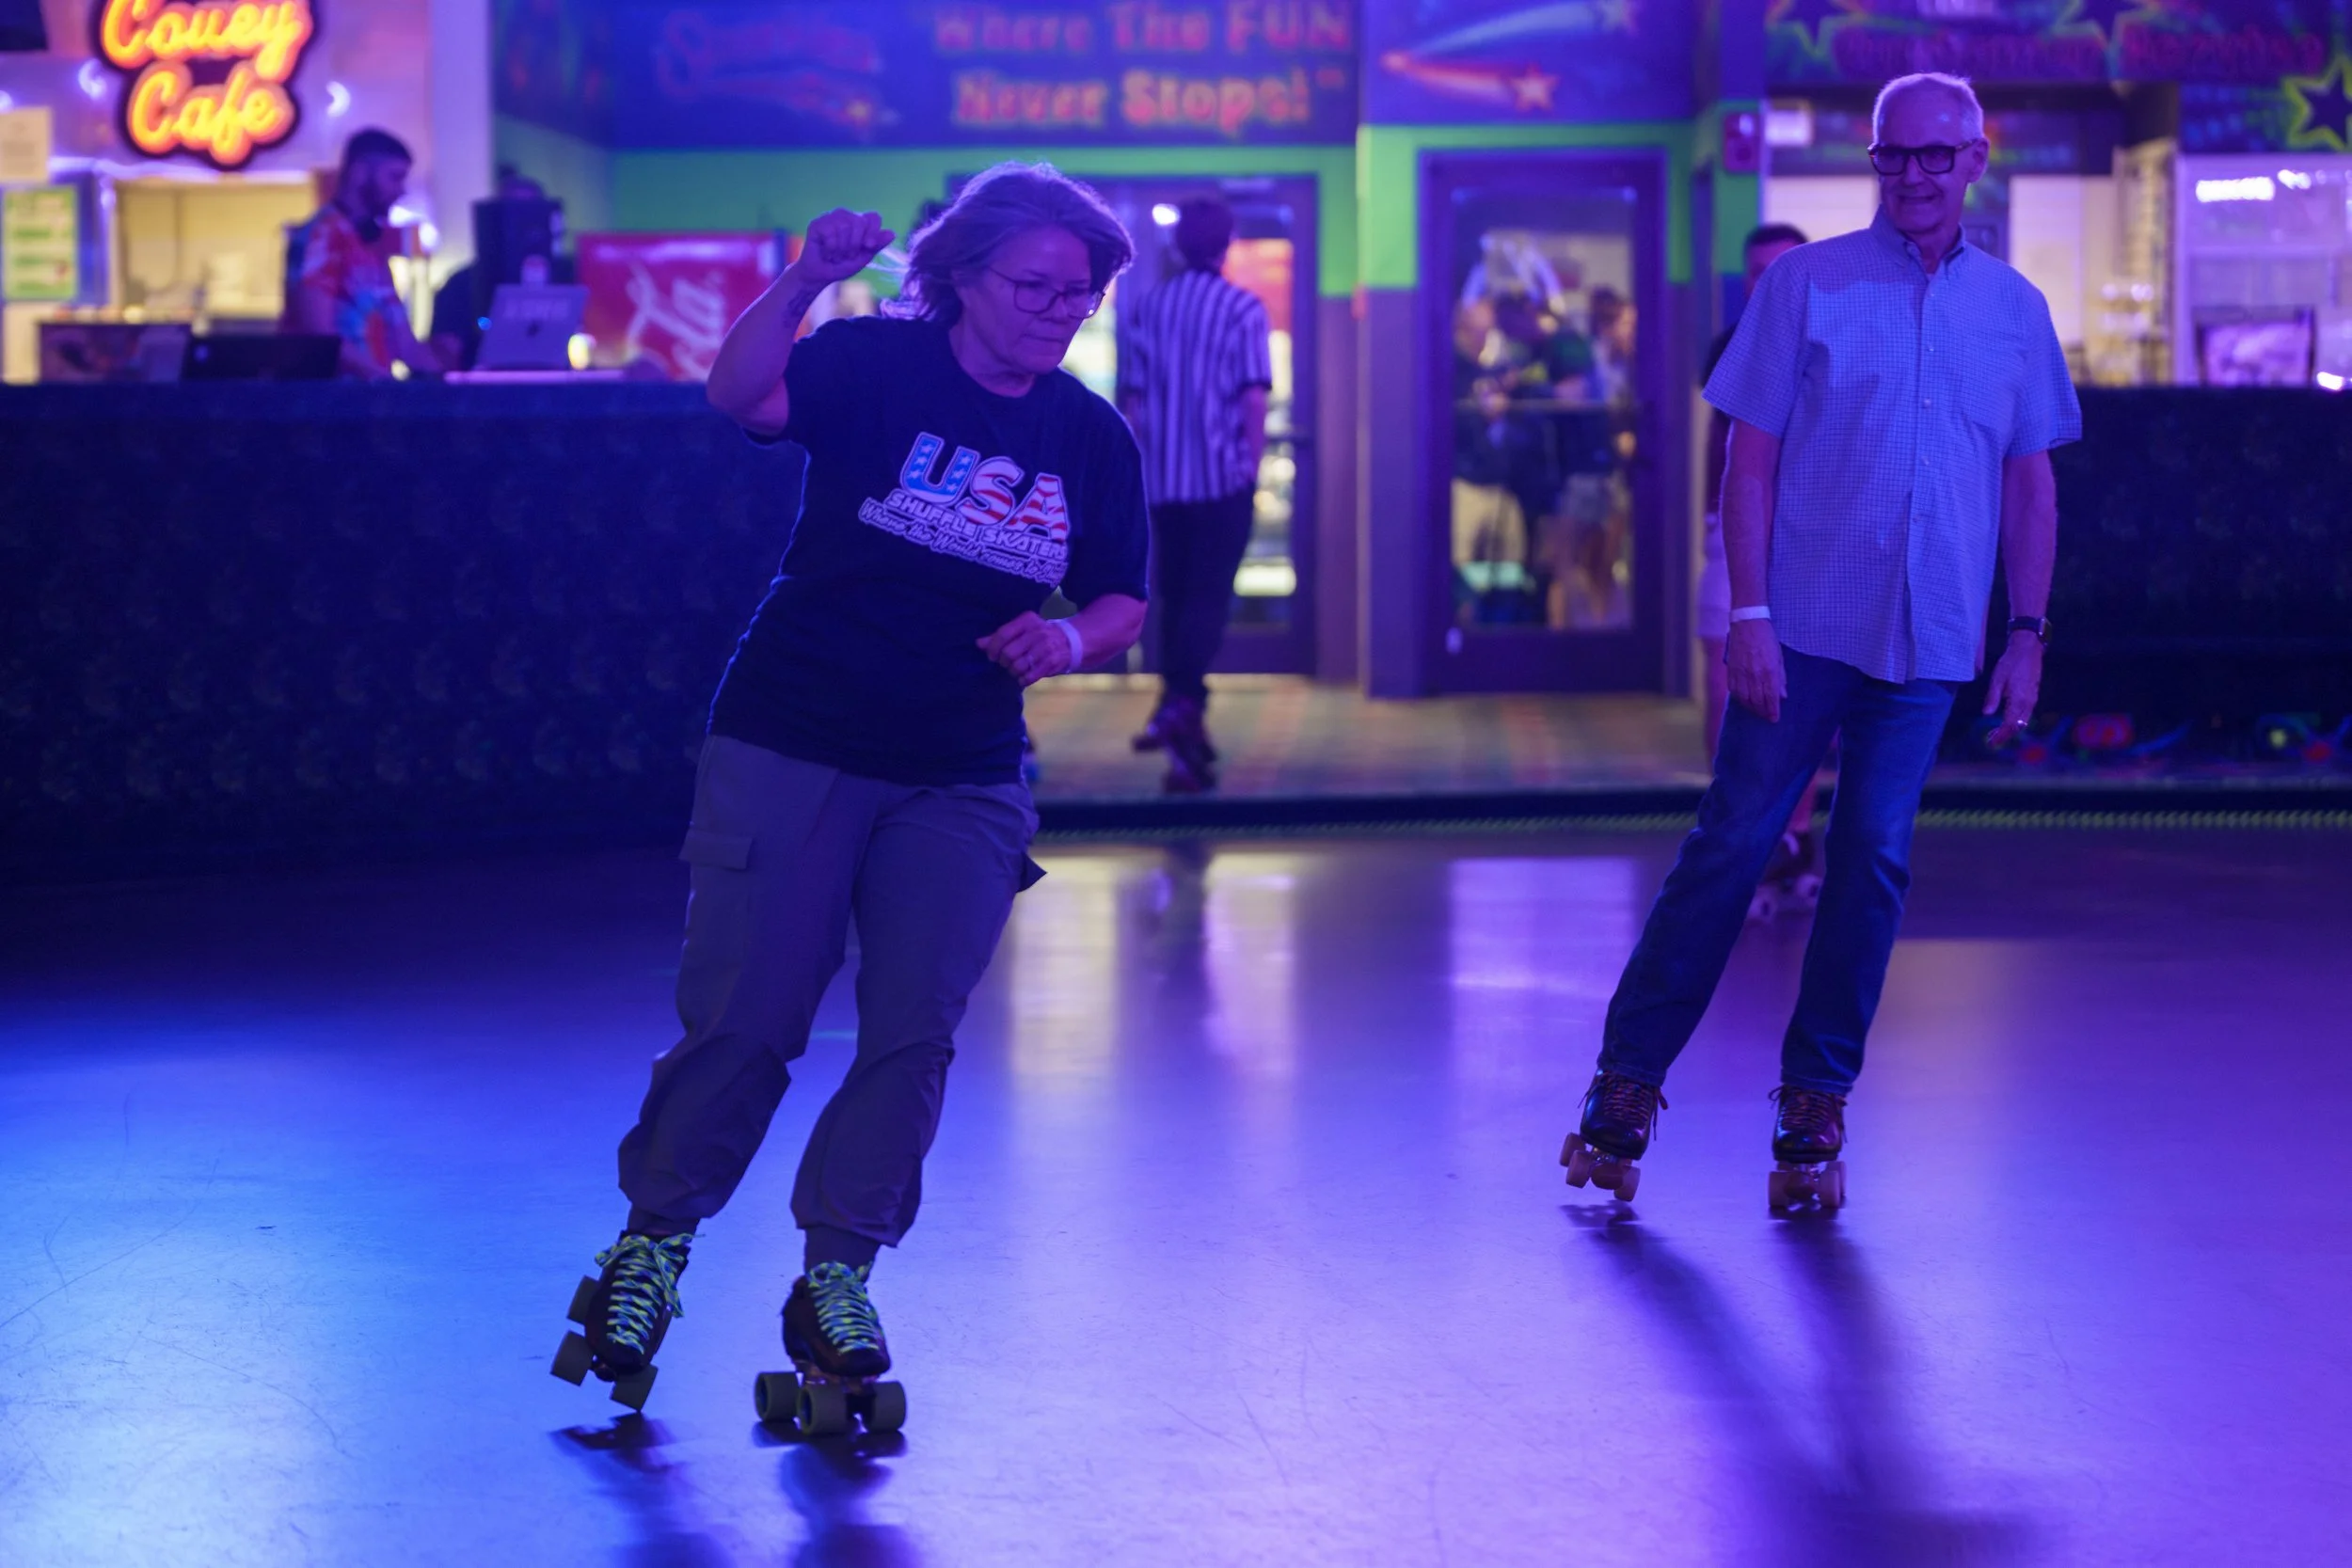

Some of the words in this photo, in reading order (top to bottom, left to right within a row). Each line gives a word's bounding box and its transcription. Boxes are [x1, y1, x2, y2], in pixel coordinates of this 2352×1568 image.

[1110, 1, 1211, 51] The
[1224, 0, 1349, 51] FUN
[130, 68, 285, 155] Cafe
[954, 72, 1106, 126] Never
[900, 432, 1071, 543] USA
[884, 492, 976, 537] SHUFFLE
[908, 520, 934, 542] the
